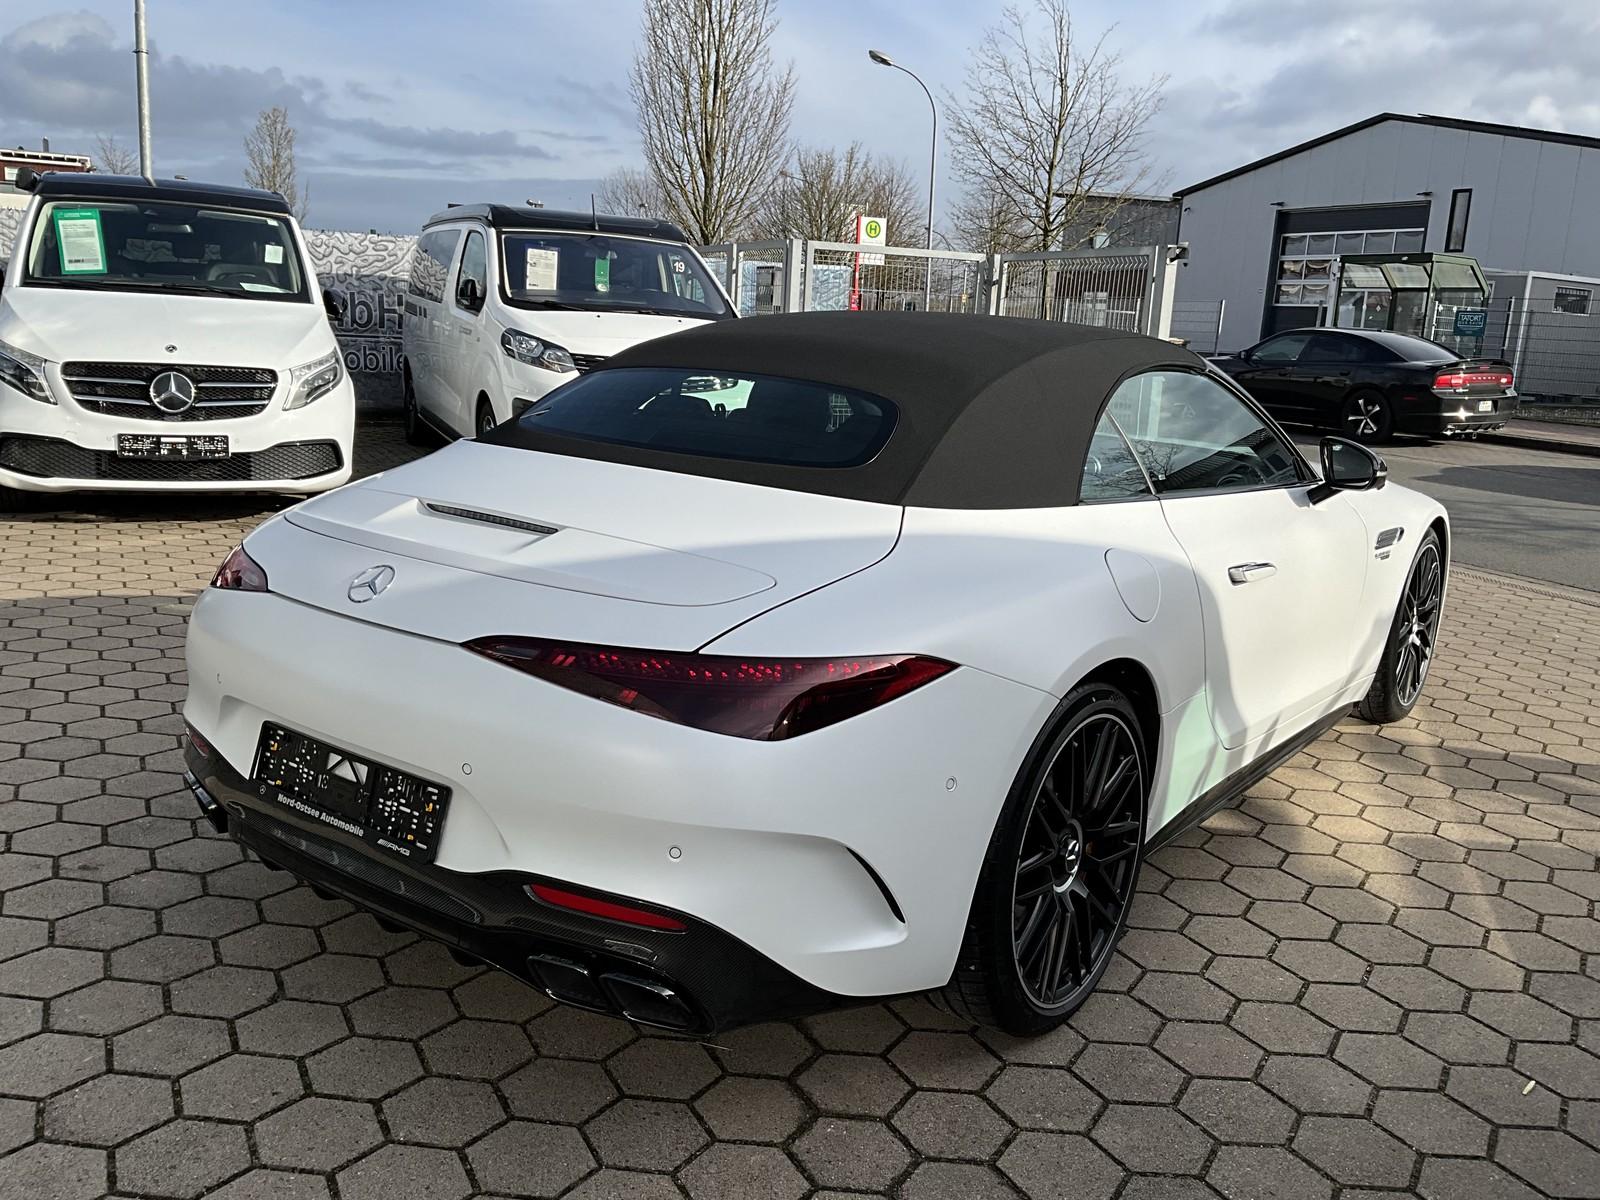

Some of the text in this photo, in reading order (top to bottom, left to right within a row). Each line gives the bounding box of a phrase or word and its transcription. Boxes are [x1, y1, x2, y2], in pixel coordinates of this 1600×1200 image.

[869, 224, 877, 234] H
[674, 261, 685, 273] 19
[277, 793, 364, 837] Nord-Ostsee Automobile
